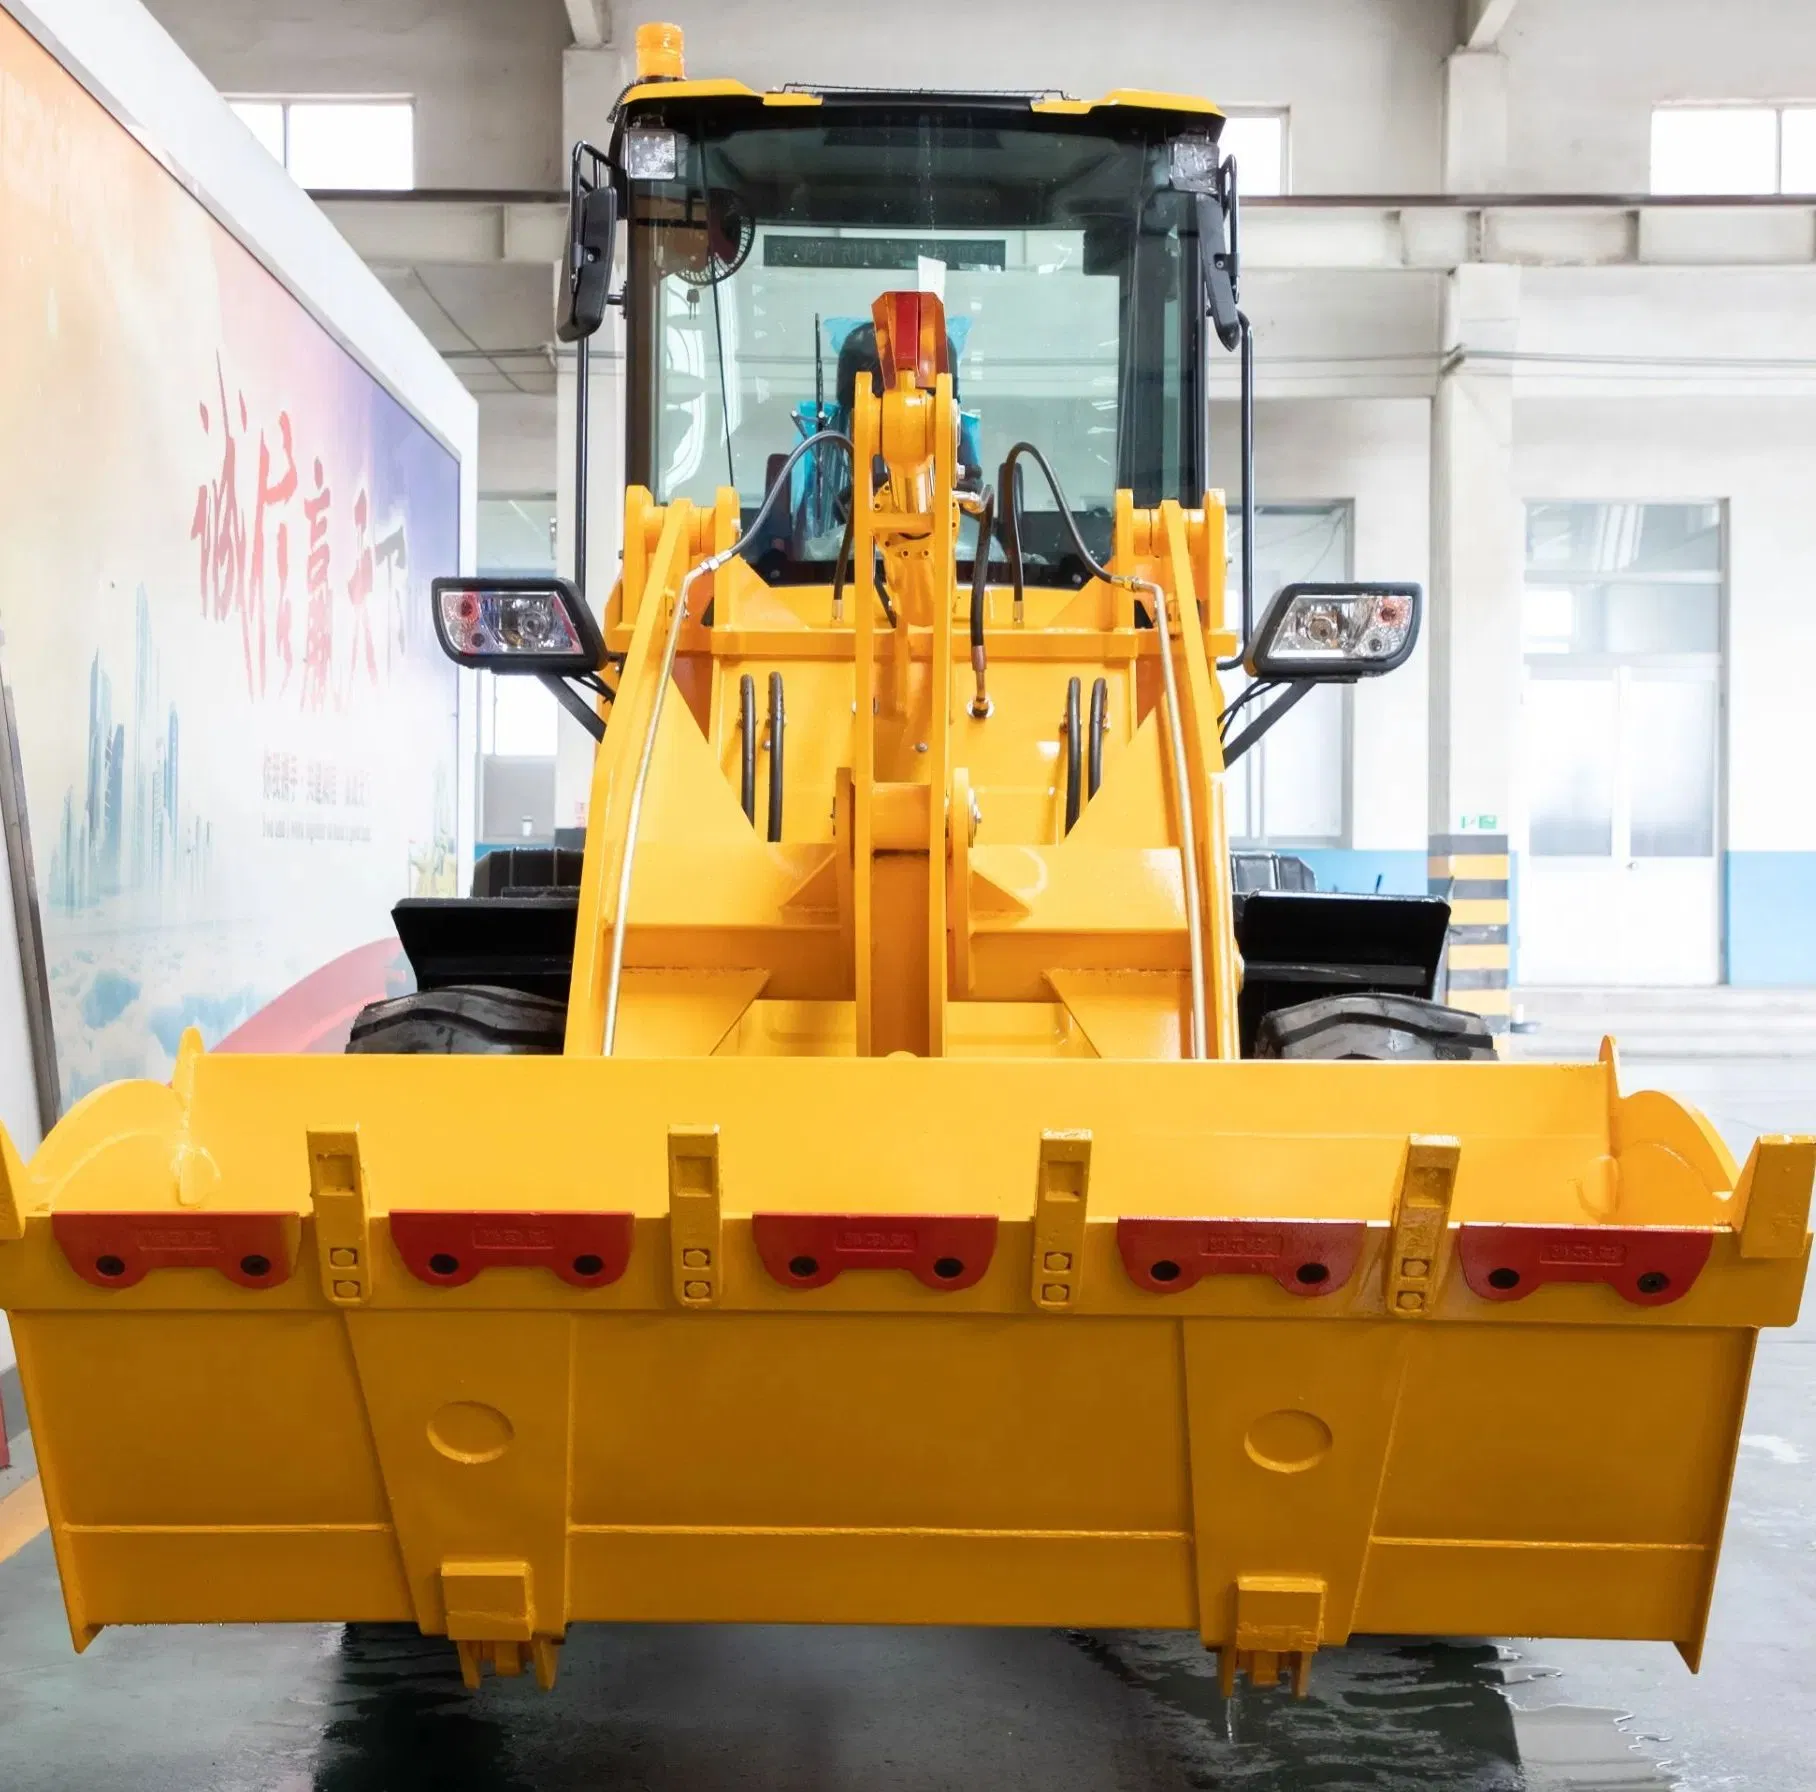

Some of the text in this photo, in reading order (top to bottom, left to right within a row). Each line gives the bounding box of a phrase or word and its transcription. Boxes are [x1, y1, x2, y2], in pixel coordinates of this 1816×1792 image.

[191, 347, 406, 712] 诚信赢天下
